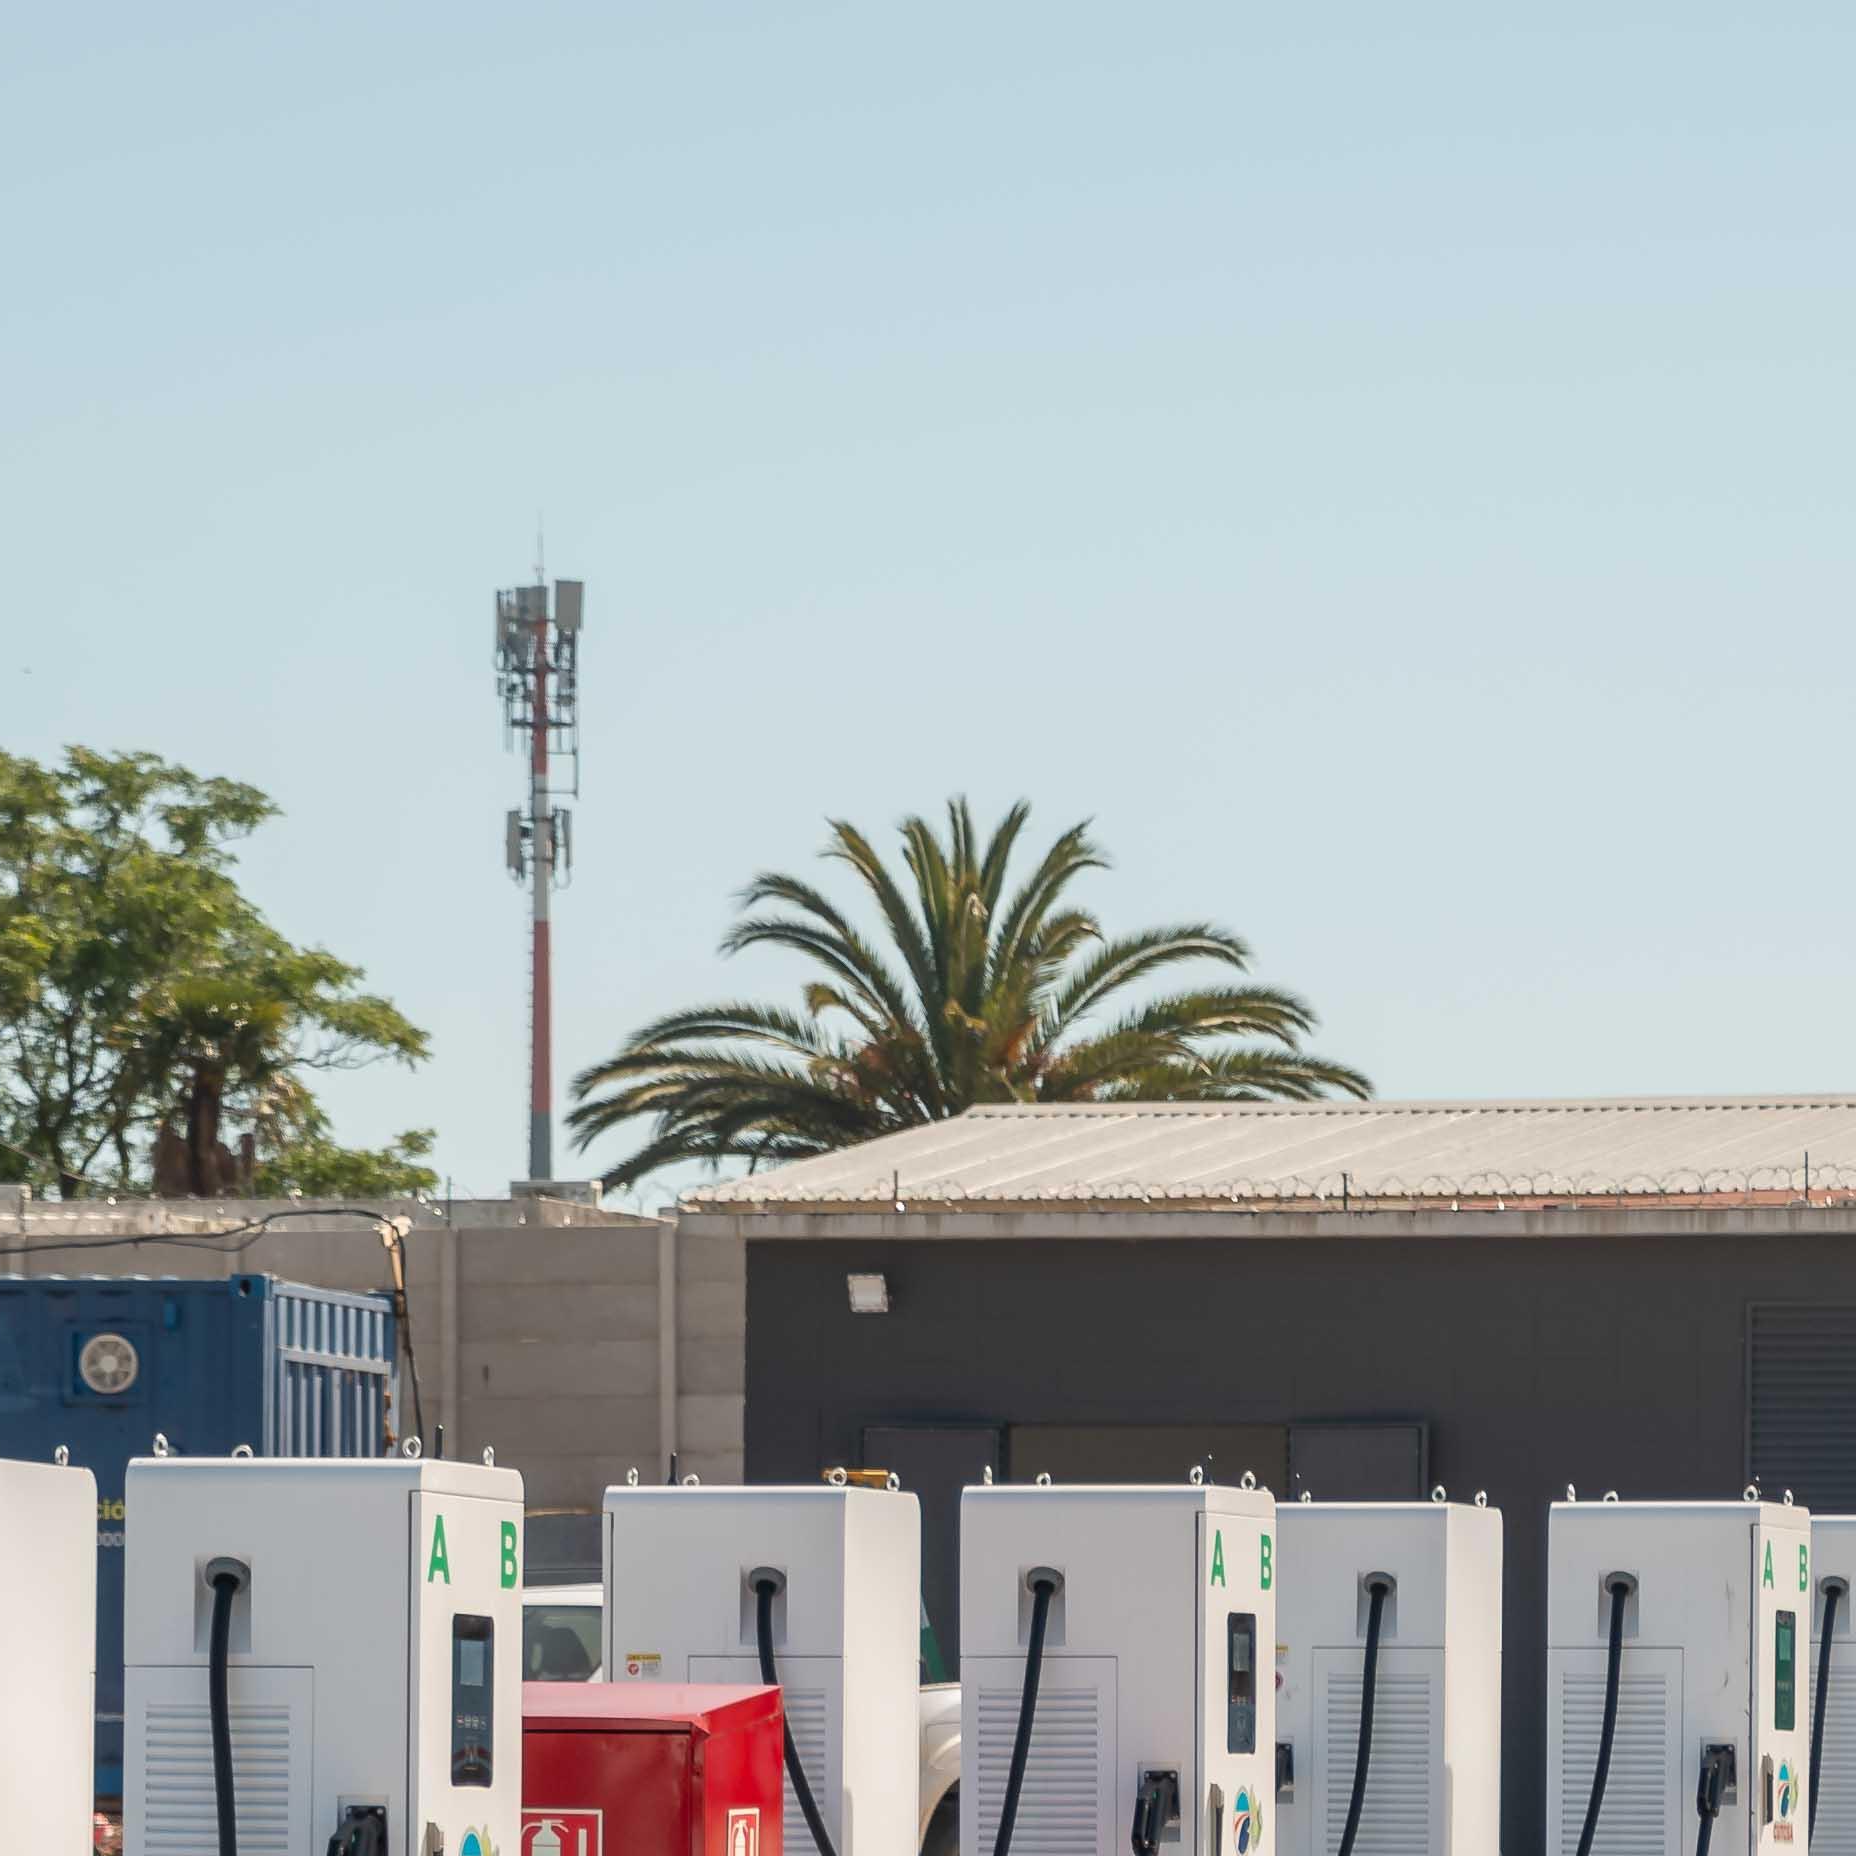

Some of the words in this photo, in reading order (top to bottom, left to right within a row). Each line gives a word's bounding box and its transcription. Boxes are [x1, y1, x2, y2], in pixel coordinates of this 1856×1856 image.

[428, 1514, 450, 1584] A
[500, 1521, 518, 1589] B
[1210, 1529, 1225, 1588] A
[1260, 1533, 1272, 1590] B
[1763, 1540, 1774, 1588] A
[1799, 1544, 1807, 1592] B
